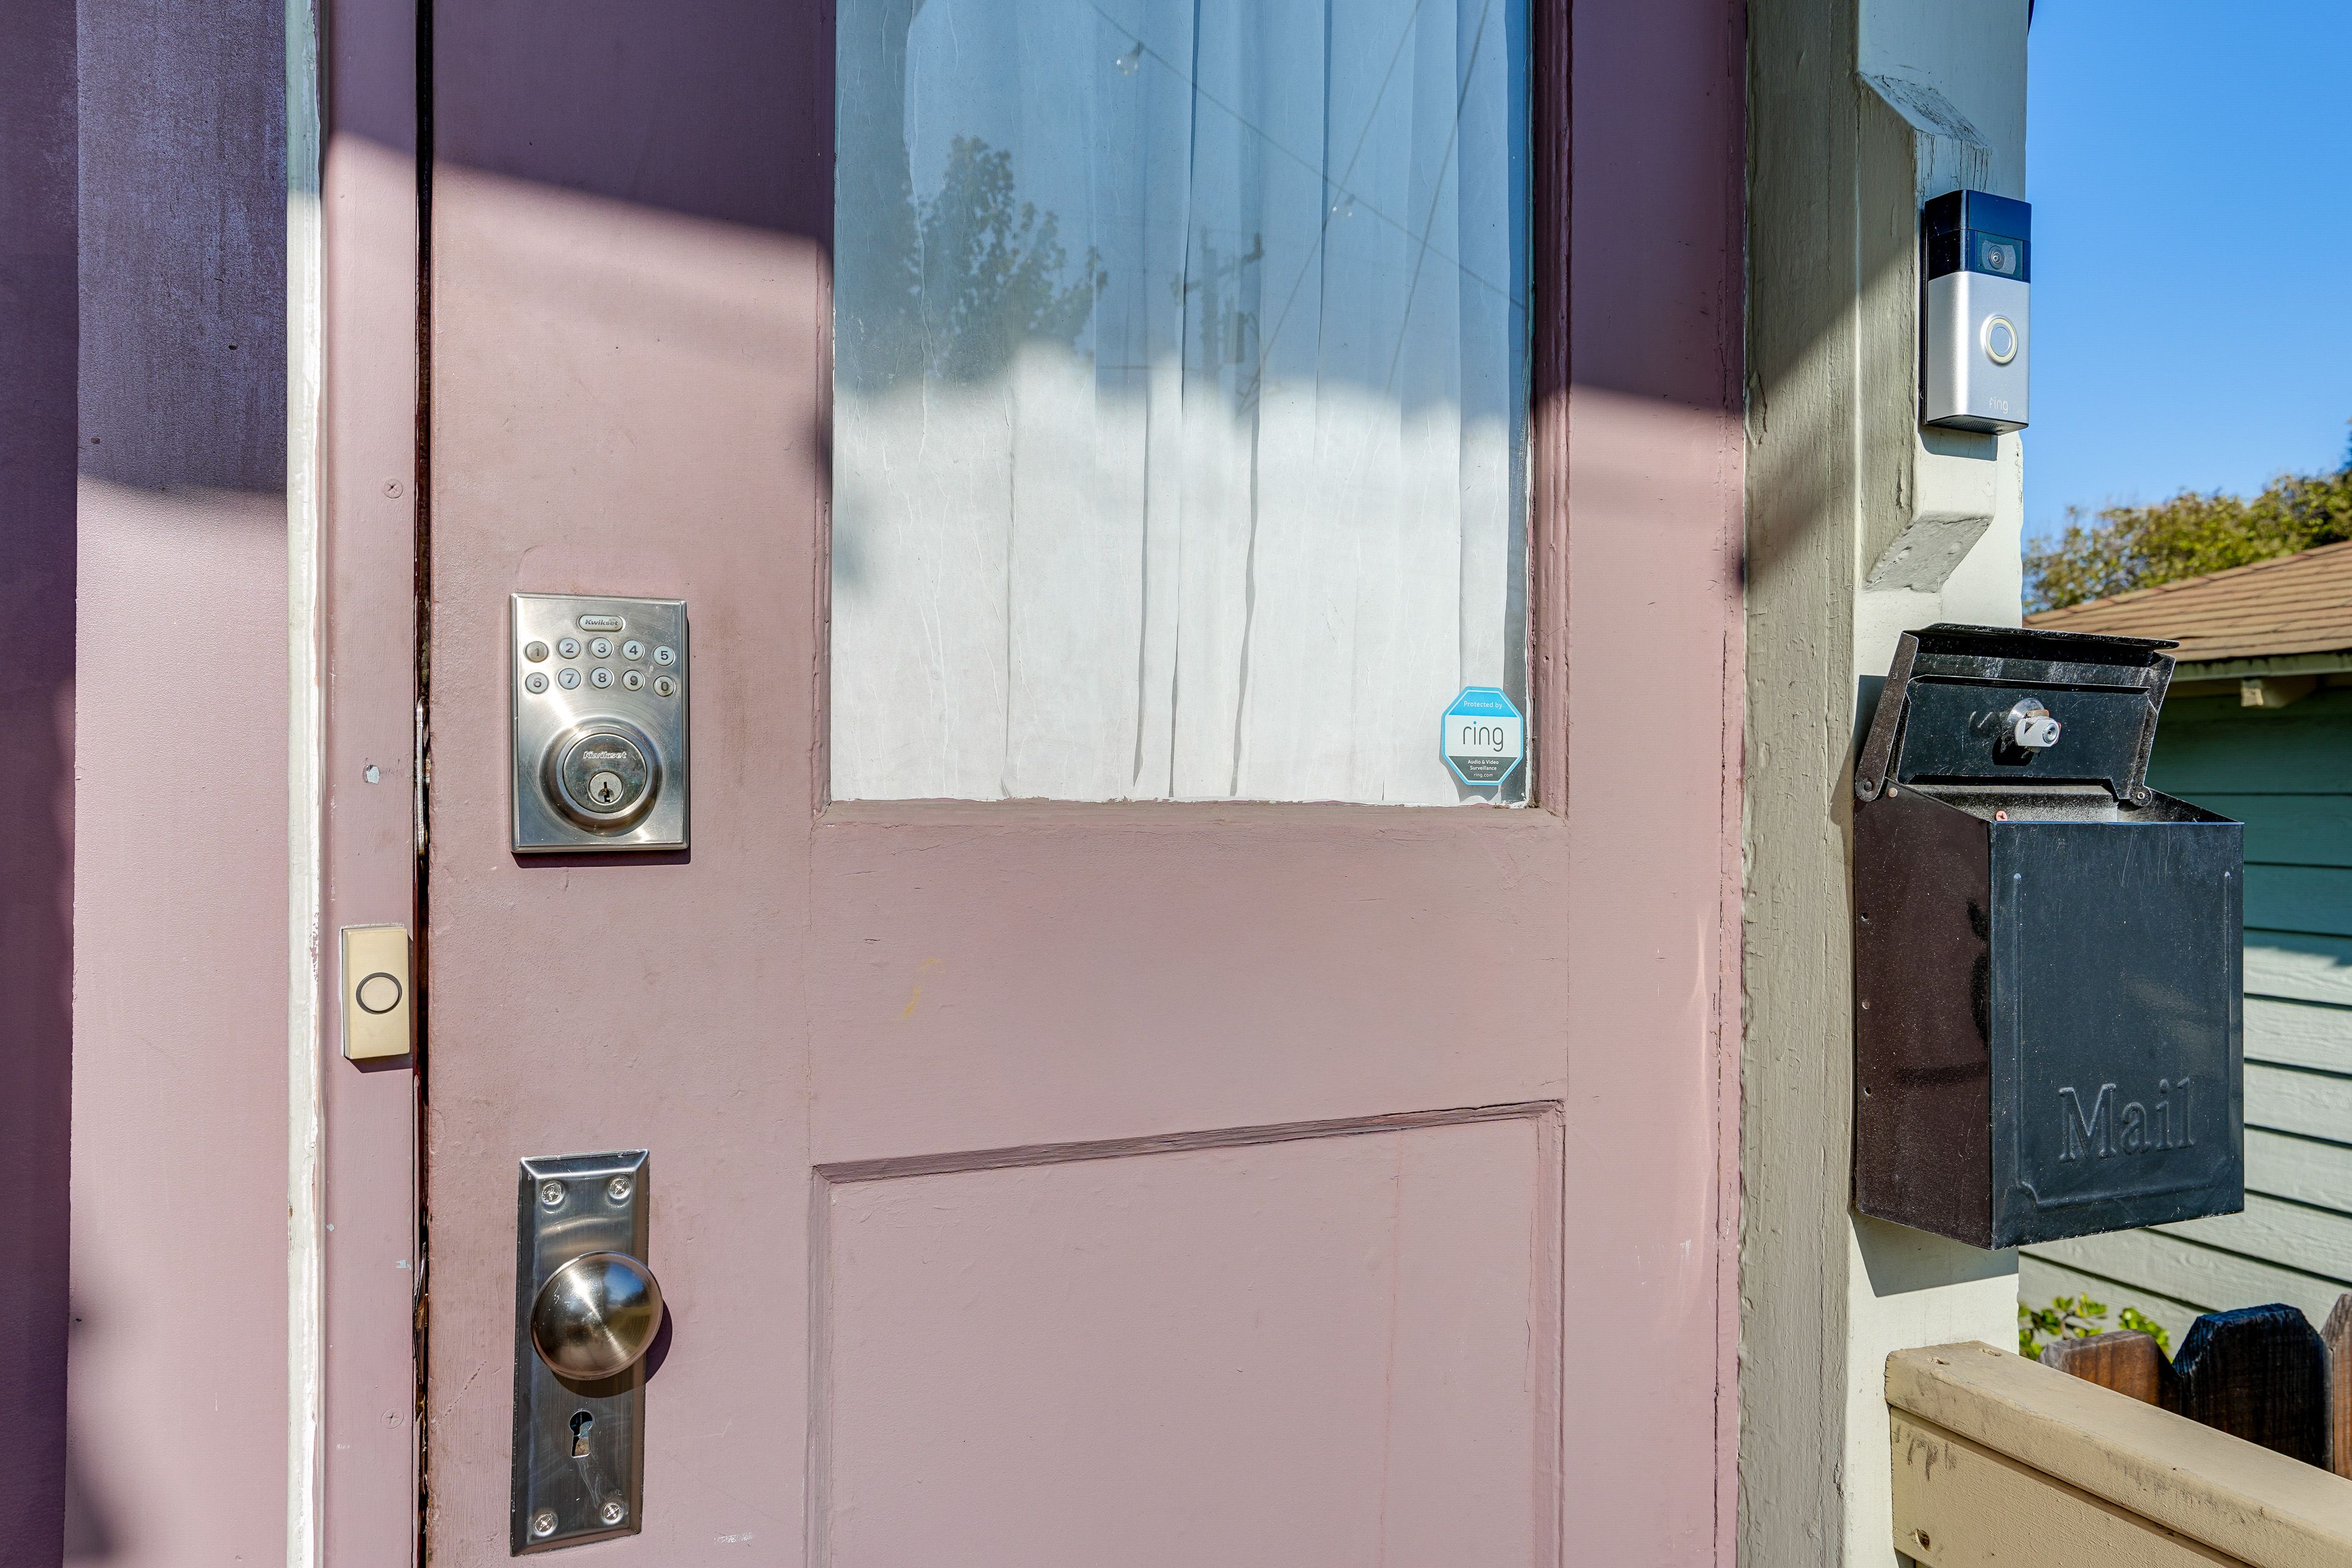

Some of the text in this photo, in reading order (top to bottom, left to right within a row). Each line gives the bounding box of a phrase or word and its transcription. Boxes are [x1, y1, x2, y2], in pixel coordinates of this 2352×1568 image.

[565, 643, 574, 653] 2
[598, 643, 606, 653] 3
[629, 645, 638, 655] 4
[660, 650, 669, 660] 5
[533, 673, 669, 692] 6 7 8 9 0
[1463, 721, 1504, 752] ring
[2059, 1077, 2195, 1163] Mail
